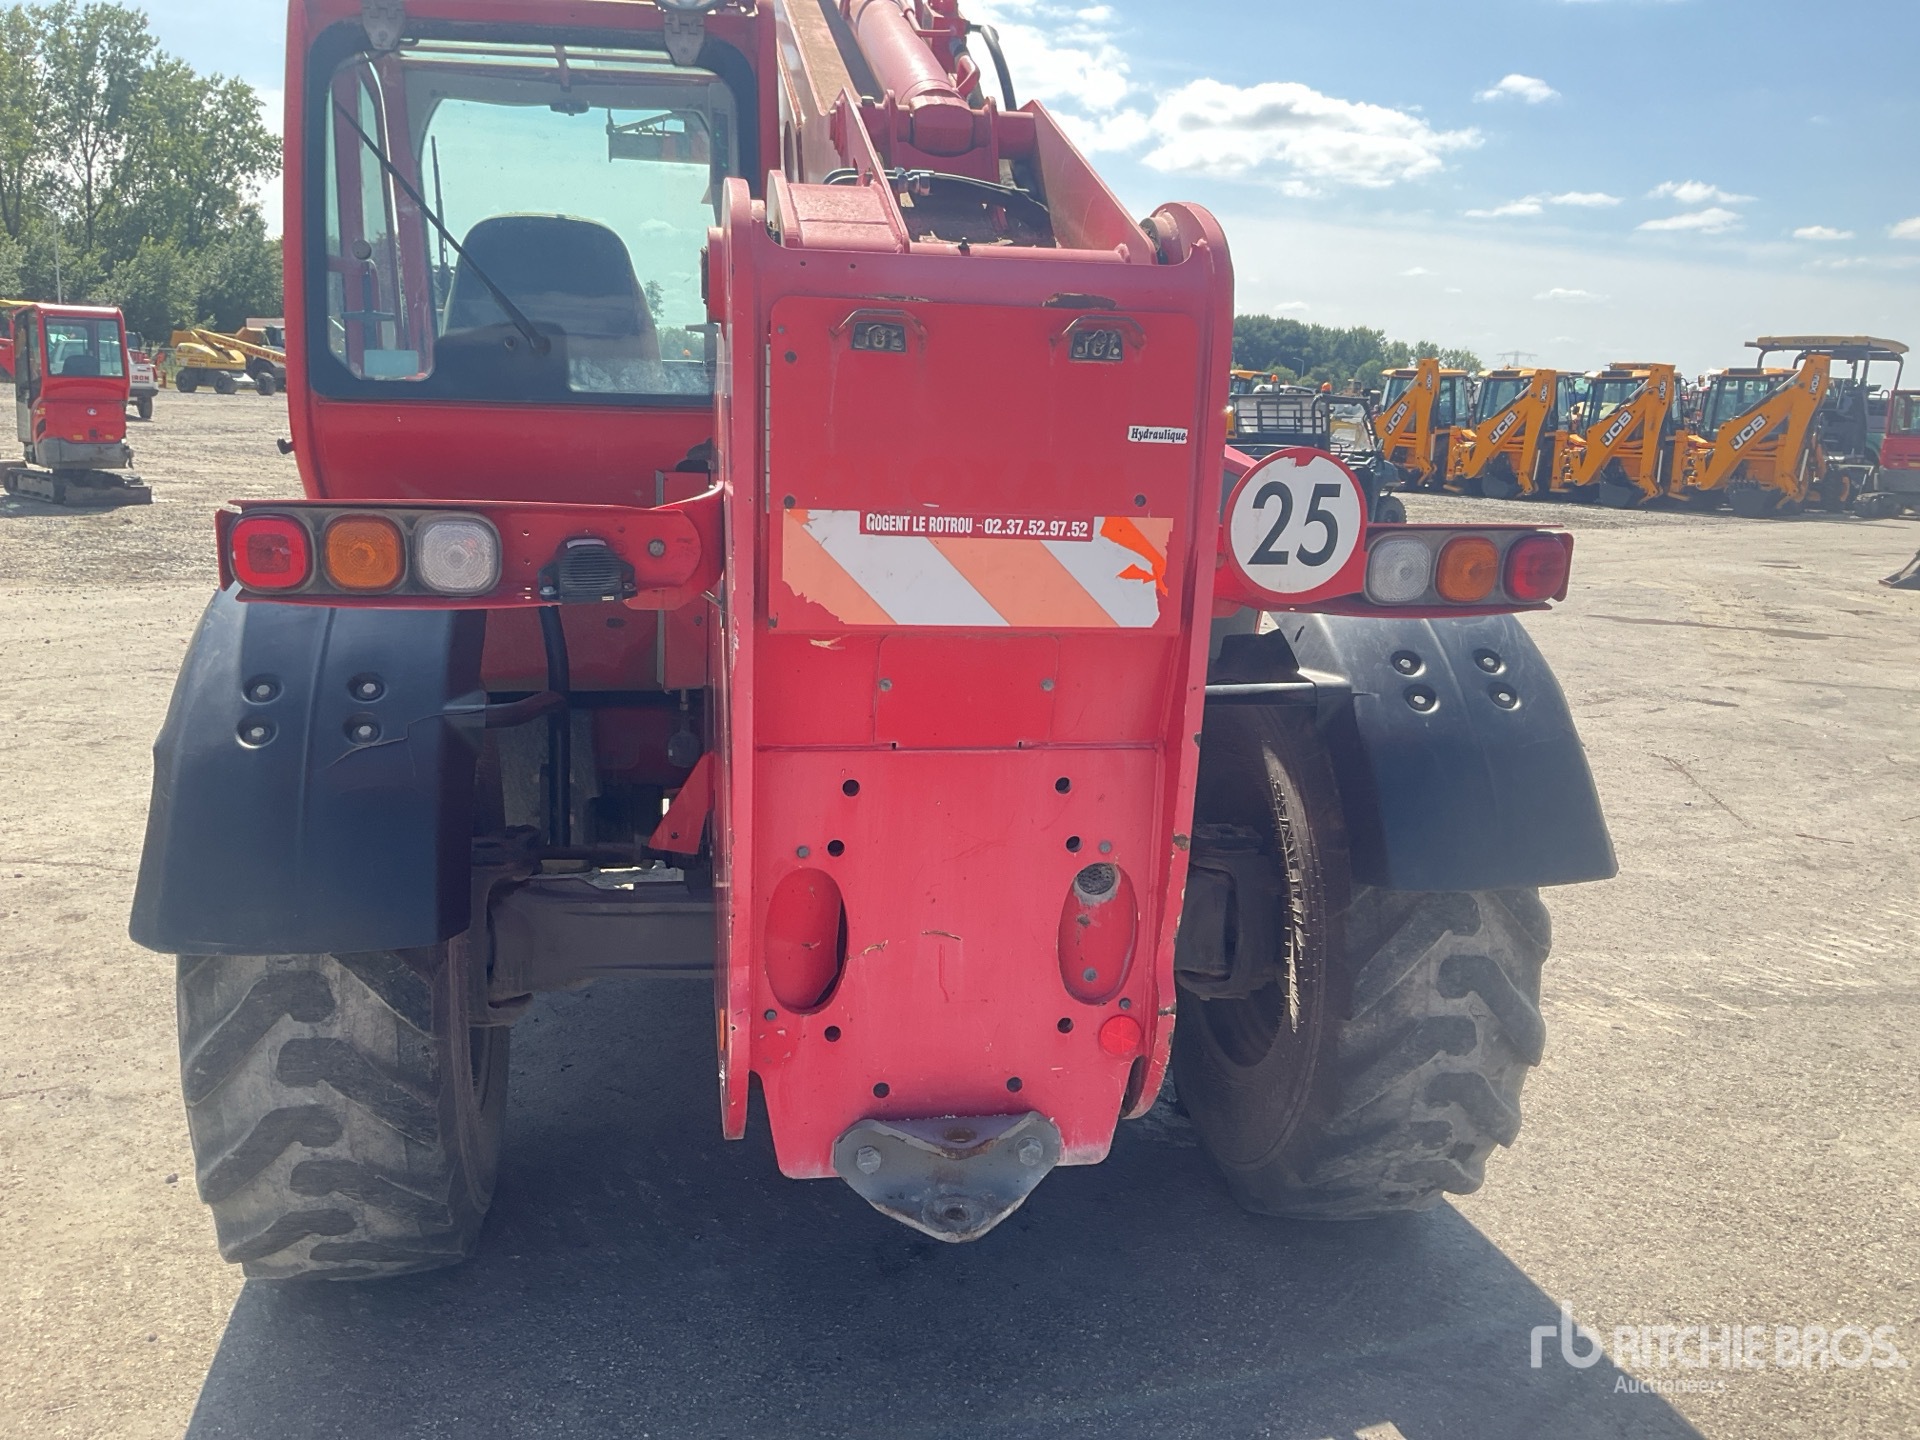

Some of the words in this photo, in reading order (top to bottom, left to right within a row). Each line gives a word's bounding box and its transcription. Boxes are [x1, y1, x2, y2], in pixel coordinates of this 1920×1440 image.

[1386, 403, 1408, 434] JCB
[1490, 411, 1517, 443] JCB
[1601, 410, 1632, 446] JCB
[1731, 415, 1767, 451] JCB
[1131, 428, 1187, 443] Hydraulique
[912, 515, 926, 532] LE
[929, 516, 973, 534] ROTROU
[984, 518, 1088, 537] 02.37.52.97.52
[1247, 481, 1341, 567] 25
